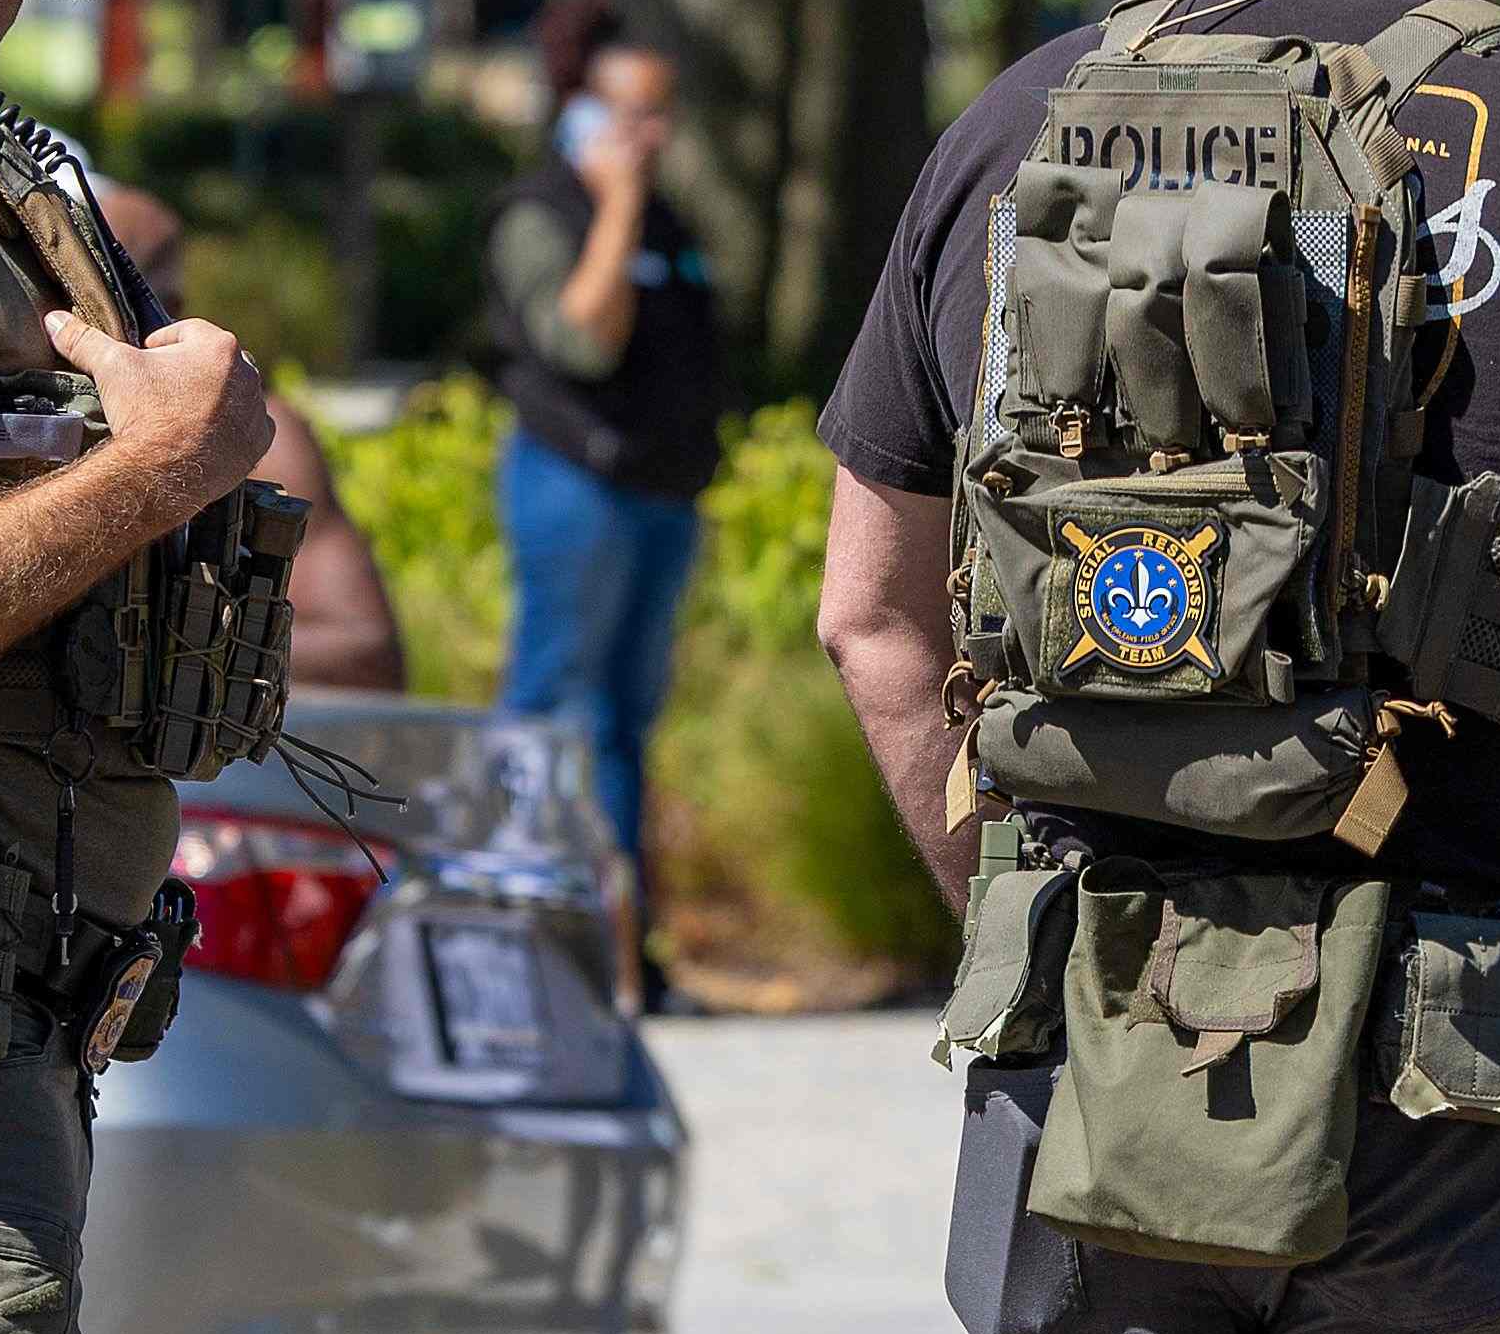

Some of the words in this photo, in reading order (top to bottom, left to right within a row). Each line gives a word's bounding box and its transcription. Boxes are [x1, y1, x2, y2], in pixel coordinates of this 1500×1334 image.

[1061, 125, 1277, 191] POLICE
[1078, 541, 1116, 619] SPECIAL
[1142, 531, 1202, 621] RESPONSE
[1119, 645, 1167, 664] TEAM
